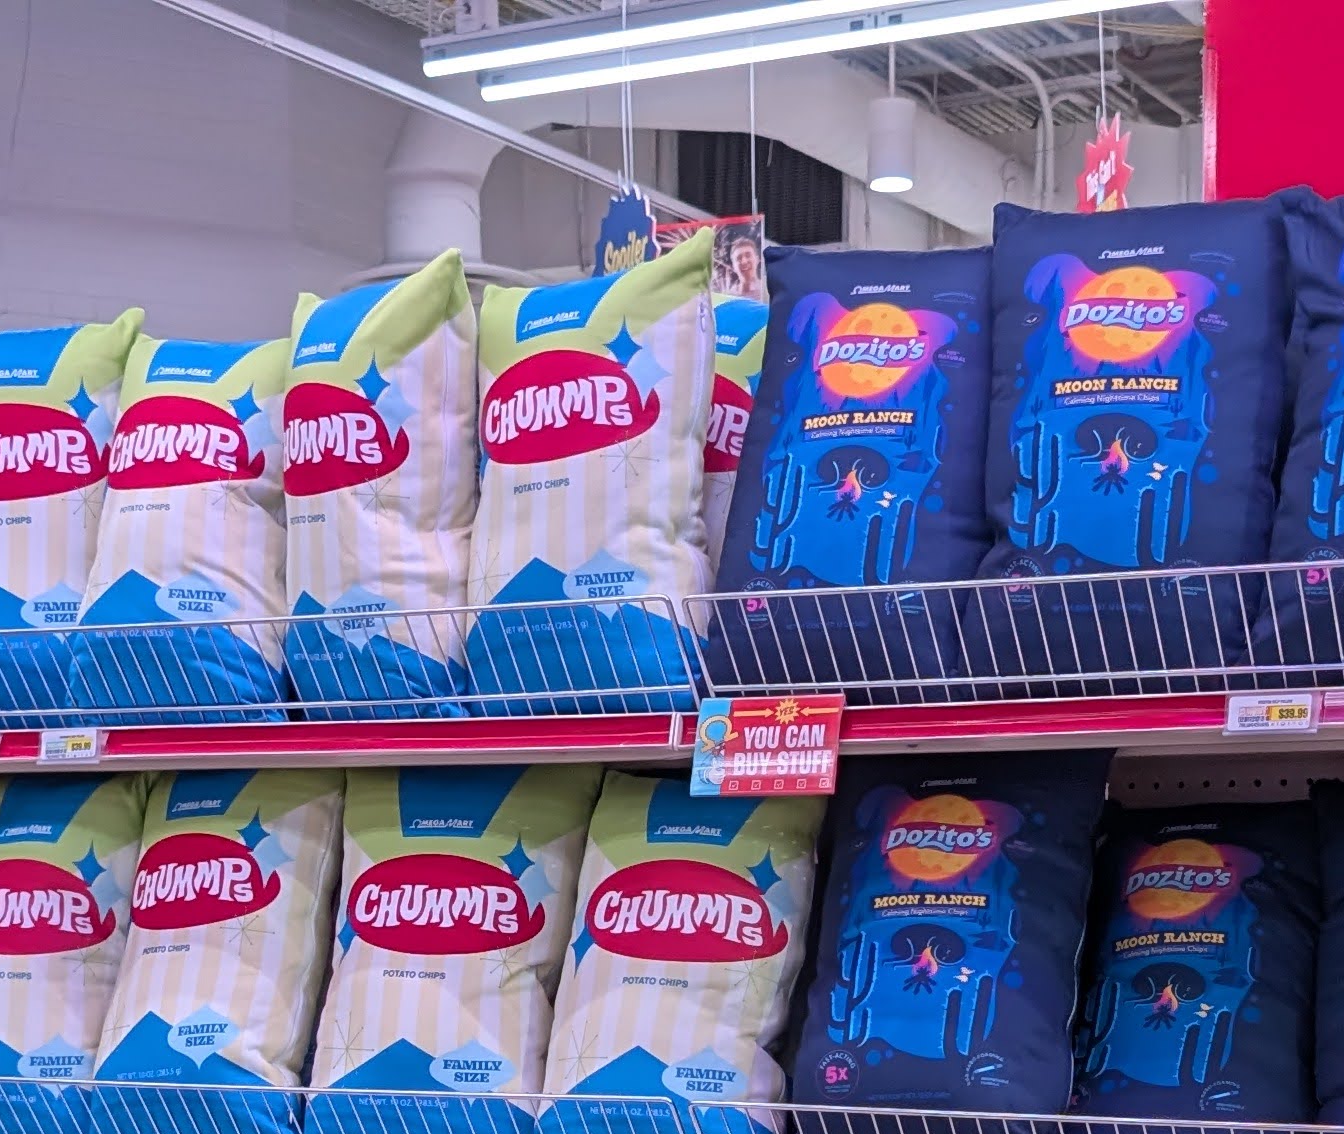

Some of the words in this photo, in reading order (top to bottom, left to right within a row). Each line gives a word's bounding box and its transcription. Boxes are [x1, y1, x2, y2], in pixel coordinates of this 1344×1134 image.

[1064, 300, 1186, 329] Dozito's
[818, 338, 925, 366] Dozito's
[1055, 379, 1105, 394] MOON
[1111, 376, 1179, 392] RANCH
[4, 516, 32, 526] CHIPS
[779, 705, 793, 716] YES
[744, 726, 780, 749] YOU
[785, 724, 825, 747] CAN
[733, 753, 771, 775] BUY
[777, 750, 832, 774] STUFF
[874, 895, 919, 909] MOON
[923, 894, 986, 907] RANCH
[622, 976, 654, 986] POTATO
[657, 977, 688, 988] CHIPS
[178, 1024, 228, 1040] FAMILY
[185, 1034, 215, 1046] SIZE
[675, 1066, 736, 1082] FAMILY
[686, 1080, 724, 1094] SIZE
